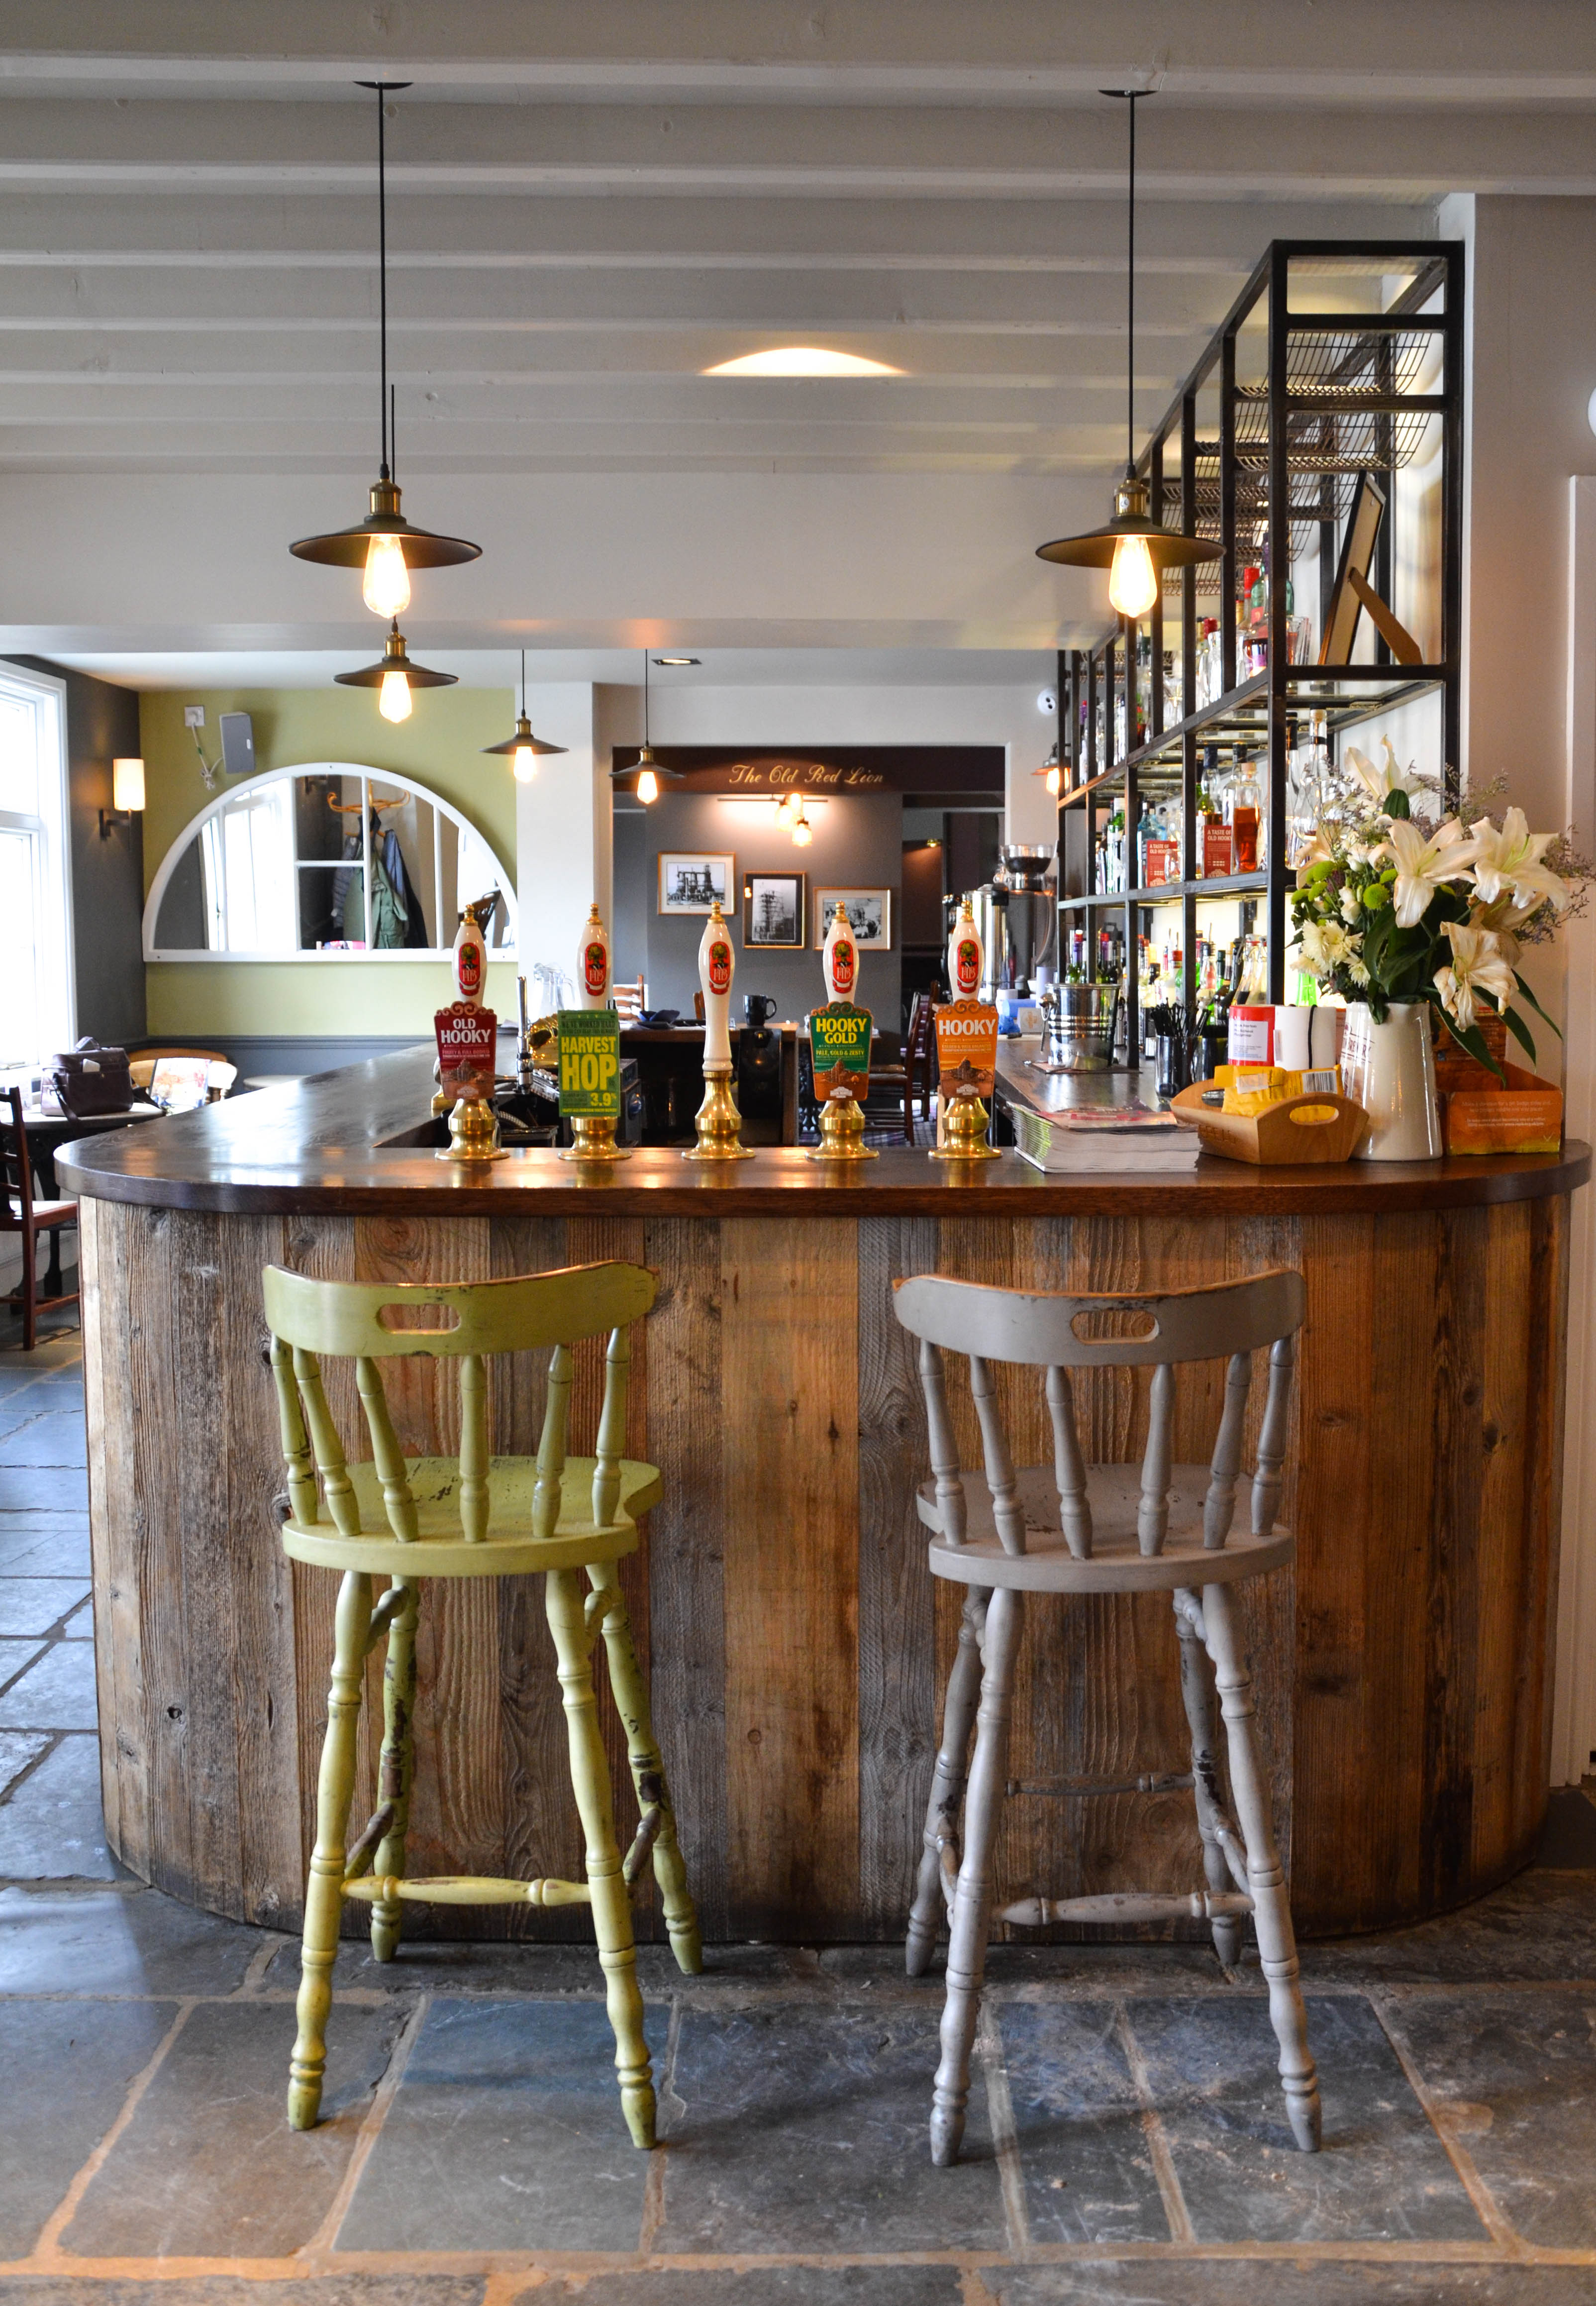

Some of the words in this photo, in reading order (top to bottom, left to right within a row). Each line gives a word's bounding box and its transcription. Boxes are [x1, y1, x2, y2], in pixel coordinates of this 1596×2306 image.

[729, 764, 762, 783] The
[769, 765, 798, 783] Old
[804, 764, 843, 783] Red
[844, 766, 884, 784] Lion
[453, 1019, 476, 1029] OLD
[816, 1018, 867, 1032] HOOKY
[939, 1019, 996, 1036] HOOKY
[441, 1029, 491, 1044] HOOKY
[561, 1036, 616, 1053] HARVEST
[824, 1032, 857, 1044] GOLD
[562, 1053, 617, 1091] HOP
